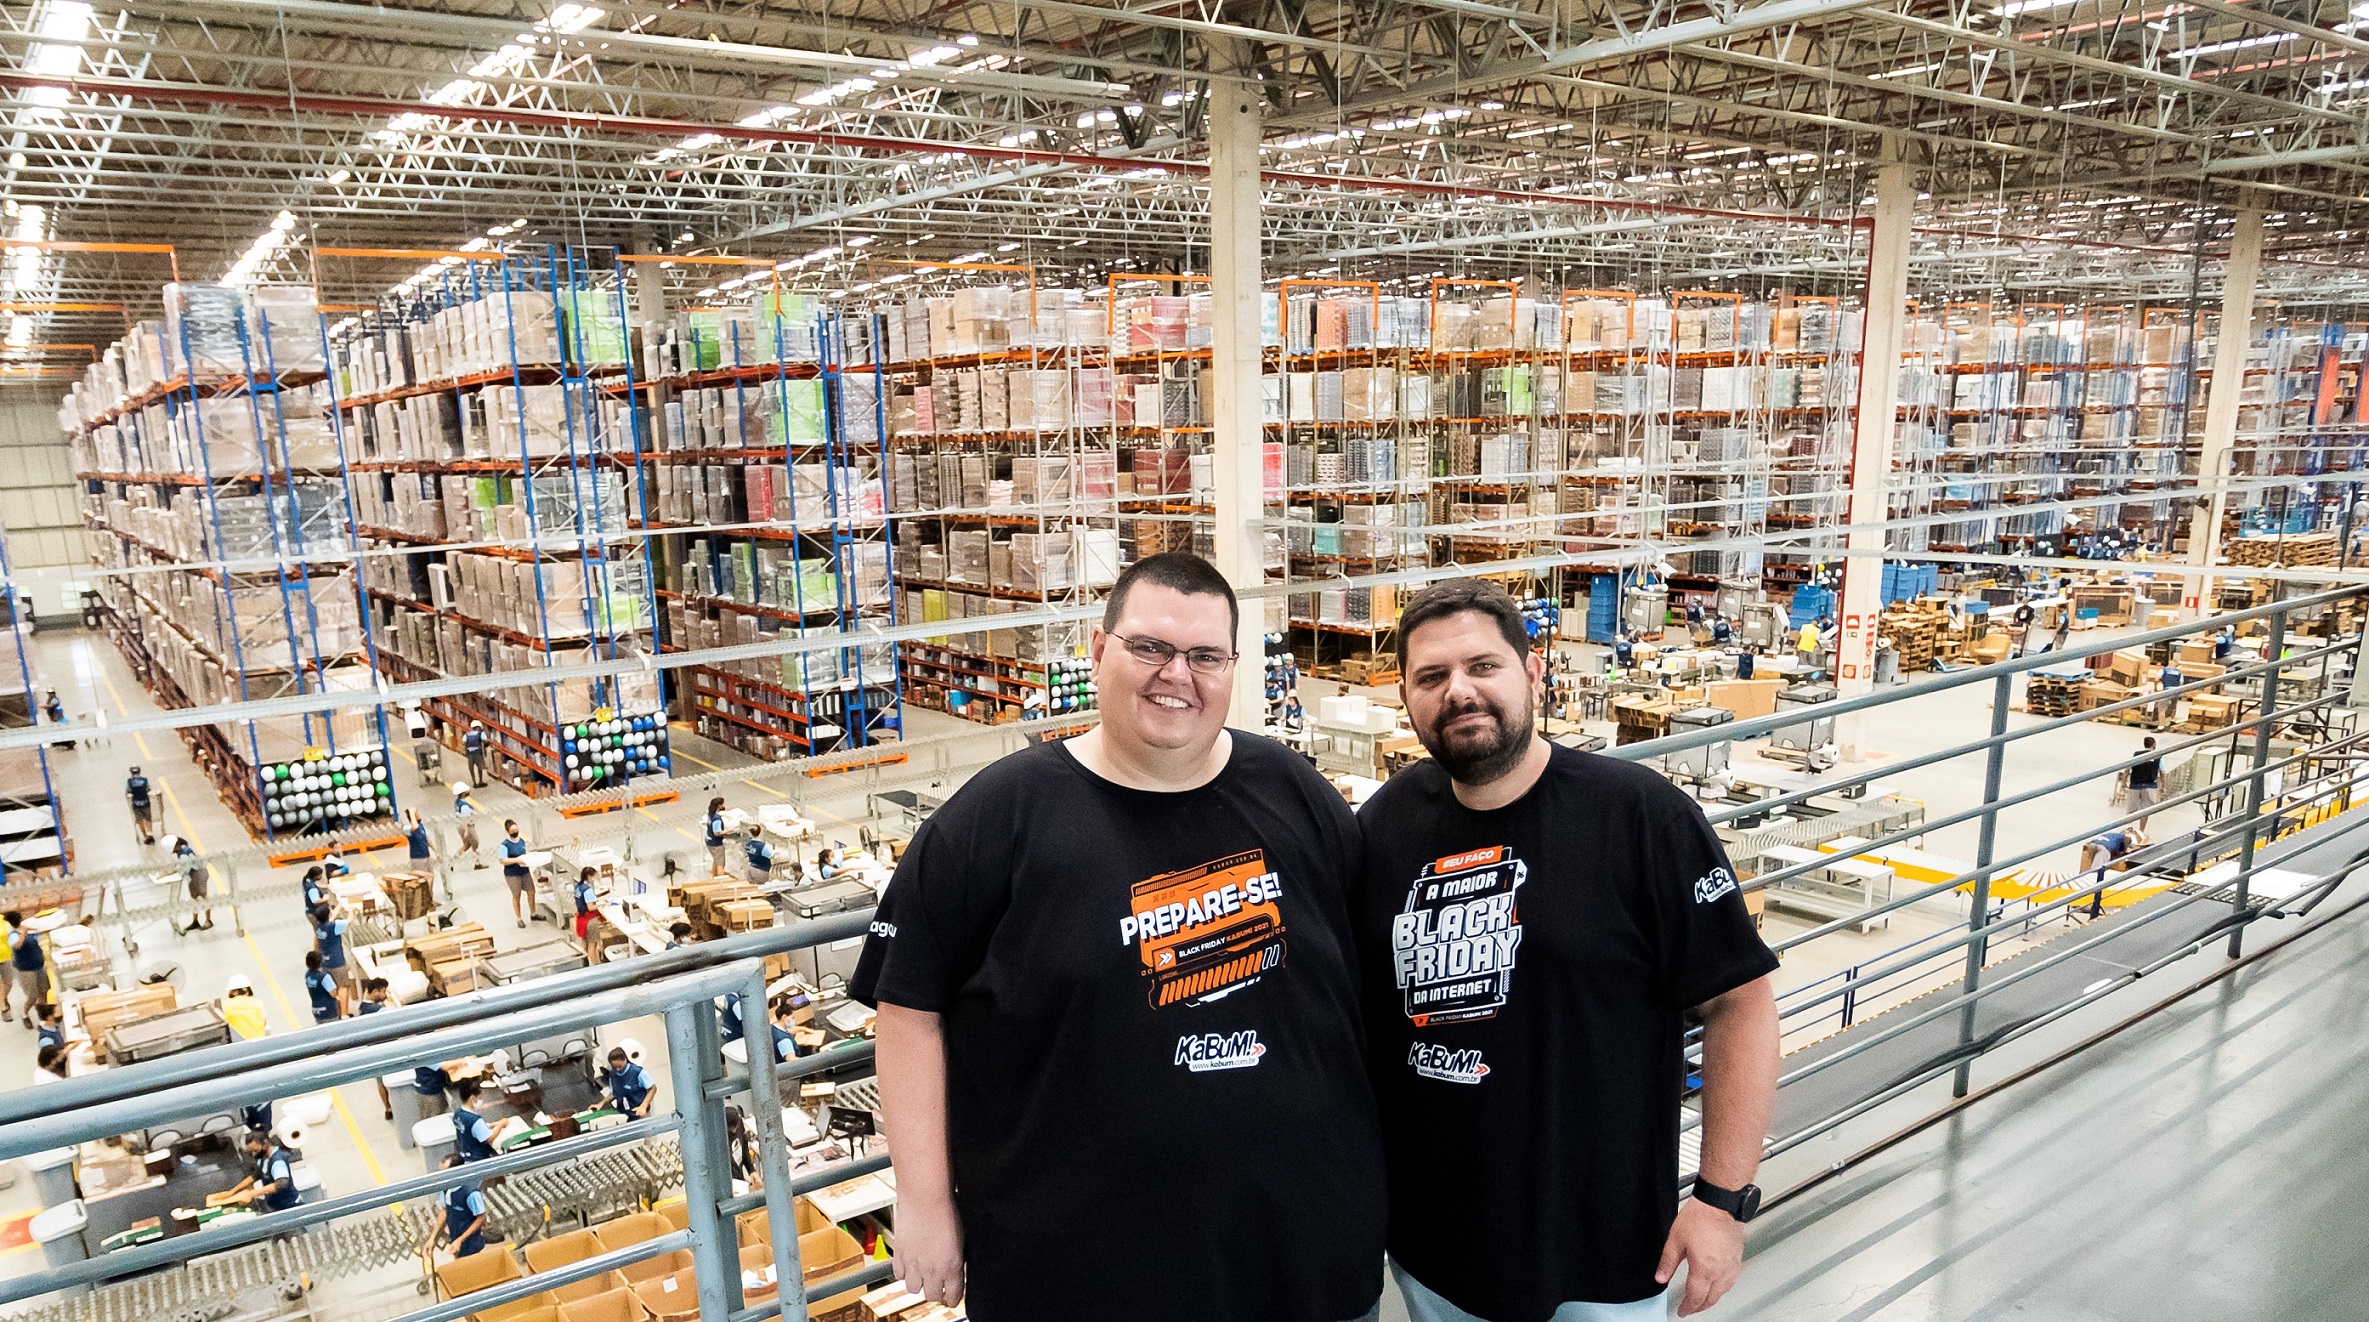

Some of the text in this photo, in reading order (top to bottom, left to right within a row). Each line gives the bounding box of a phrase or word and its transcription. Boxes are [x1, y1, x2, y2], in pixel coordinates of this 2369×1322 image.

[1426, 871, 1498, 900] A MAIOR
[1119, 872, 1283, 946] PREPARE-SE!
[1394, 894, 1513, 952] BLACK
[1179, 922, 1269, 958] BLACK FRIDAY KABUM! 2021
[1396, 928, 1519, 988] FRIDAY
[1413, 979, 1492, 1005] DA INTERNET
[1430, 1015, 1445, 1023] BLACK
[1175, 1031, 1257, 1064] KaBuM!
[1408, 1041, 1482, 1075] KaBuM!
